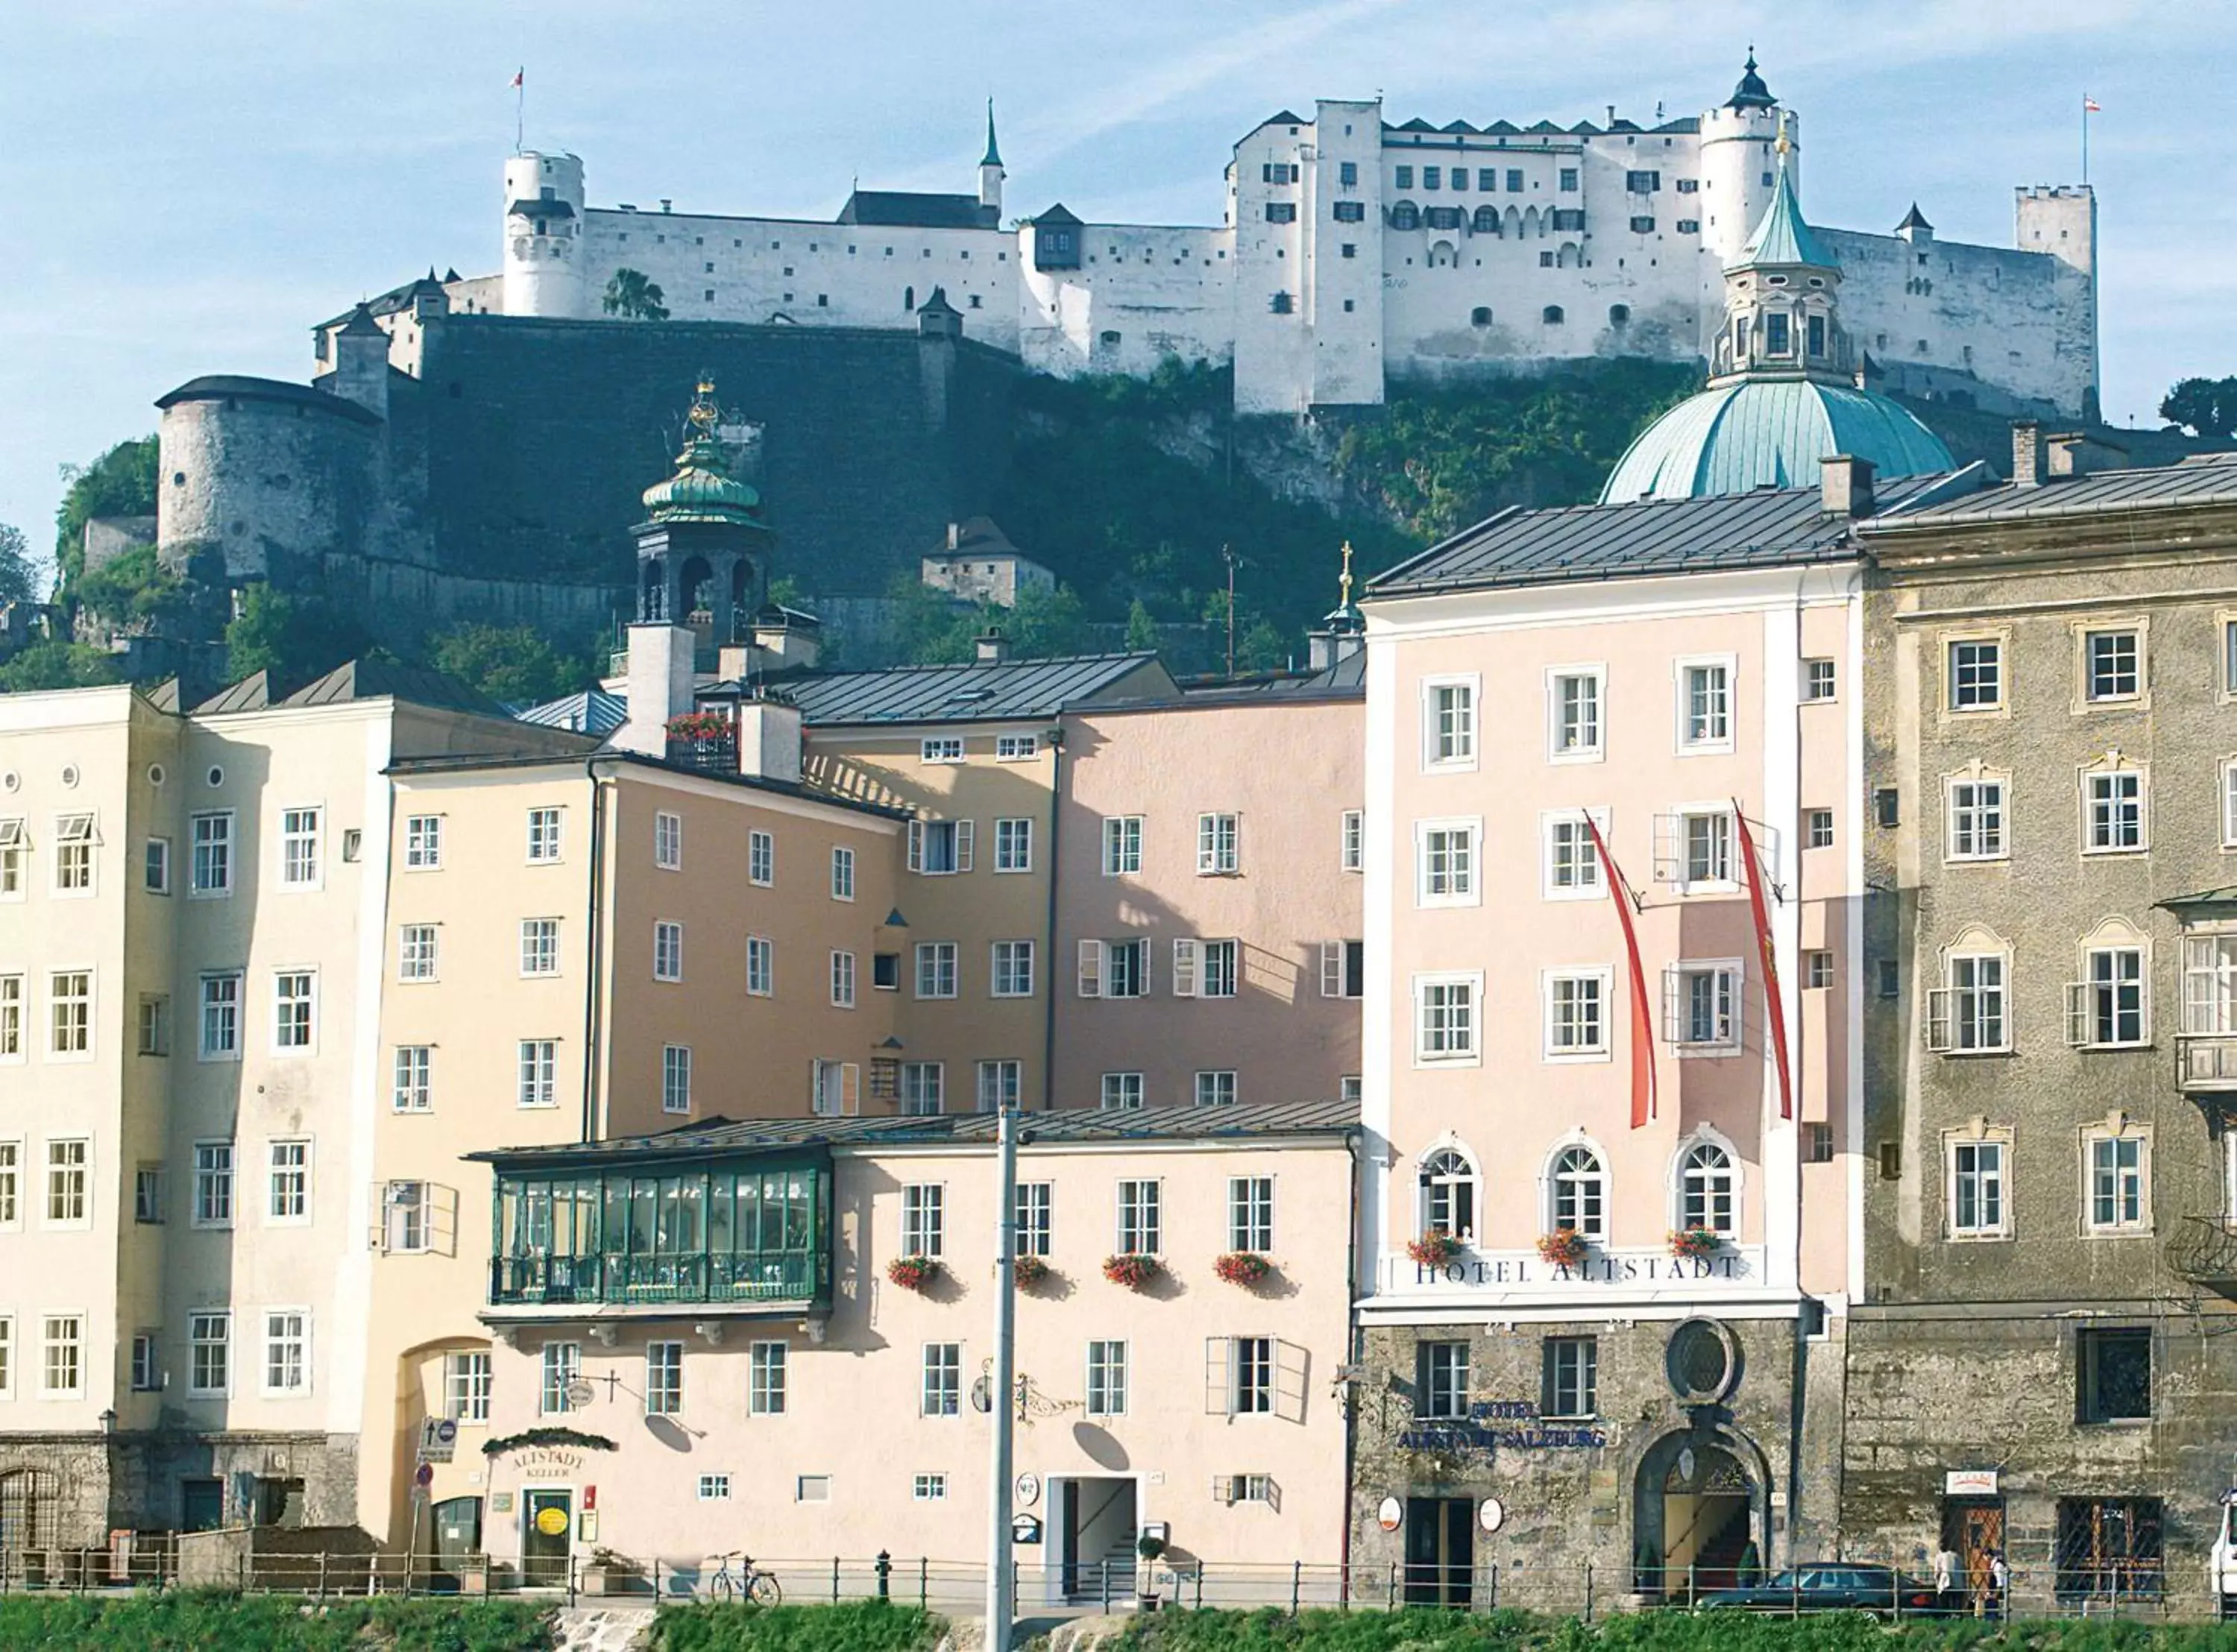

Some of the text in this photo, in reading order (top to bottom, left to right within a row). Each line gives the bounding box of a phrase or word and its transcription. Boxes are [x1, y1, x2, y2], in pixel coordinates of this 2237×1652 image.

[1415, 1255, 1737, 1284] HOTEL ALTSTADT
[513, 1451, 585, 1470] ALTSTADT
